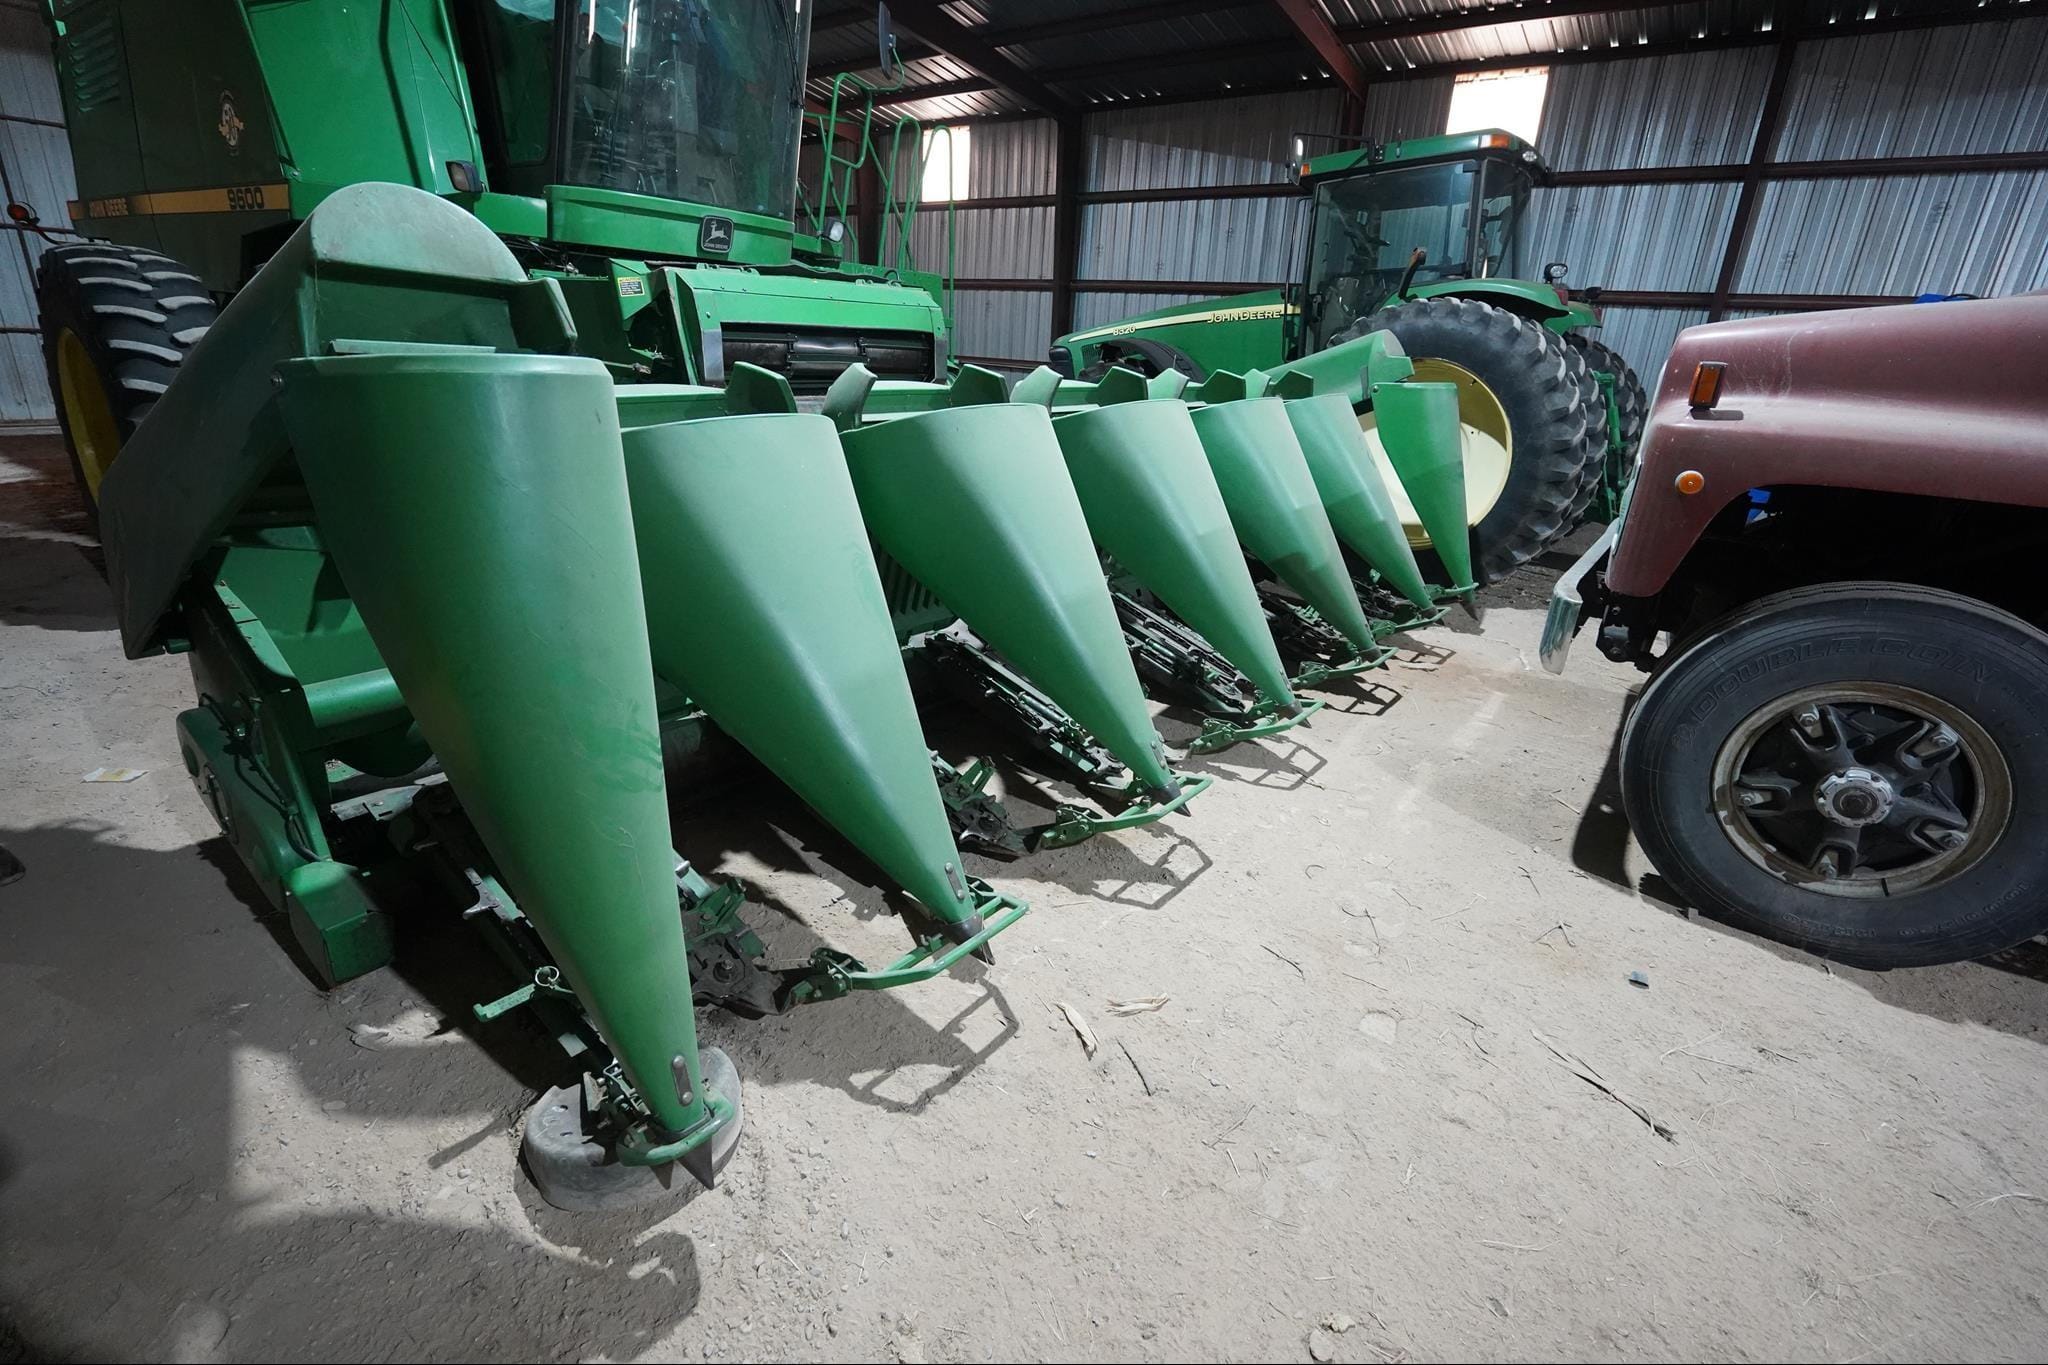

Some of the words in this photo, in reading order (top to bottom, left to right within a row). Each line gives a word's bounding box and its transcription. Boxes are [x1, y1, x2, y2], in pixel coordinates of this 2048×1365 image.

[104, 198, 129, 216] DEERE
[1207, 312, 1240, 324] JOHN
[1240, 309, 1281, 321] DEERE
[1691, 637, 1862, 723] DOUBLE
[1869, 636, 2001, 684] COIN
